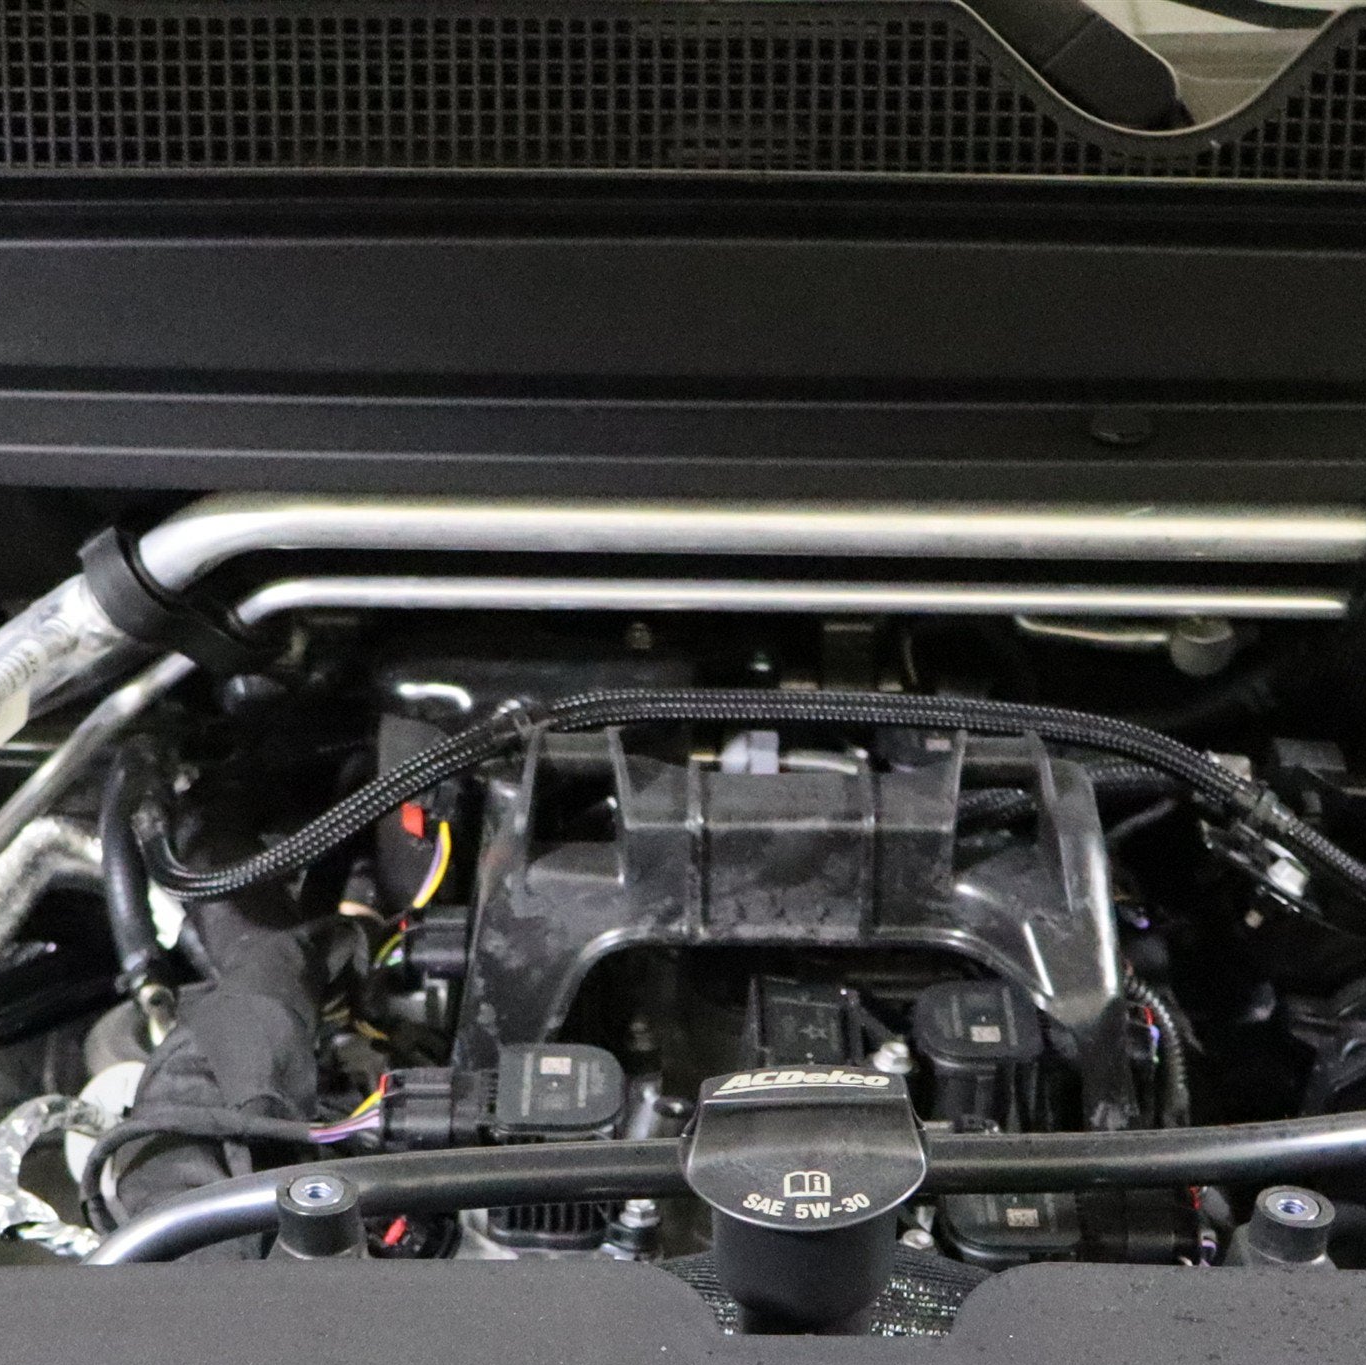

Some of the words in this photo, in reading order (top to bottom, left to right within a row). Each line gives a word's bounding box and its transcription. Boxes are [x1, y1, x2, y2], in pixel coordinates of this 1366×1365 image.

[718, 1070, 890, 1092] ACDelco
[742, 1193, 785, 1217] SAE
[794, 1193, 871, 1219] 5W-30
